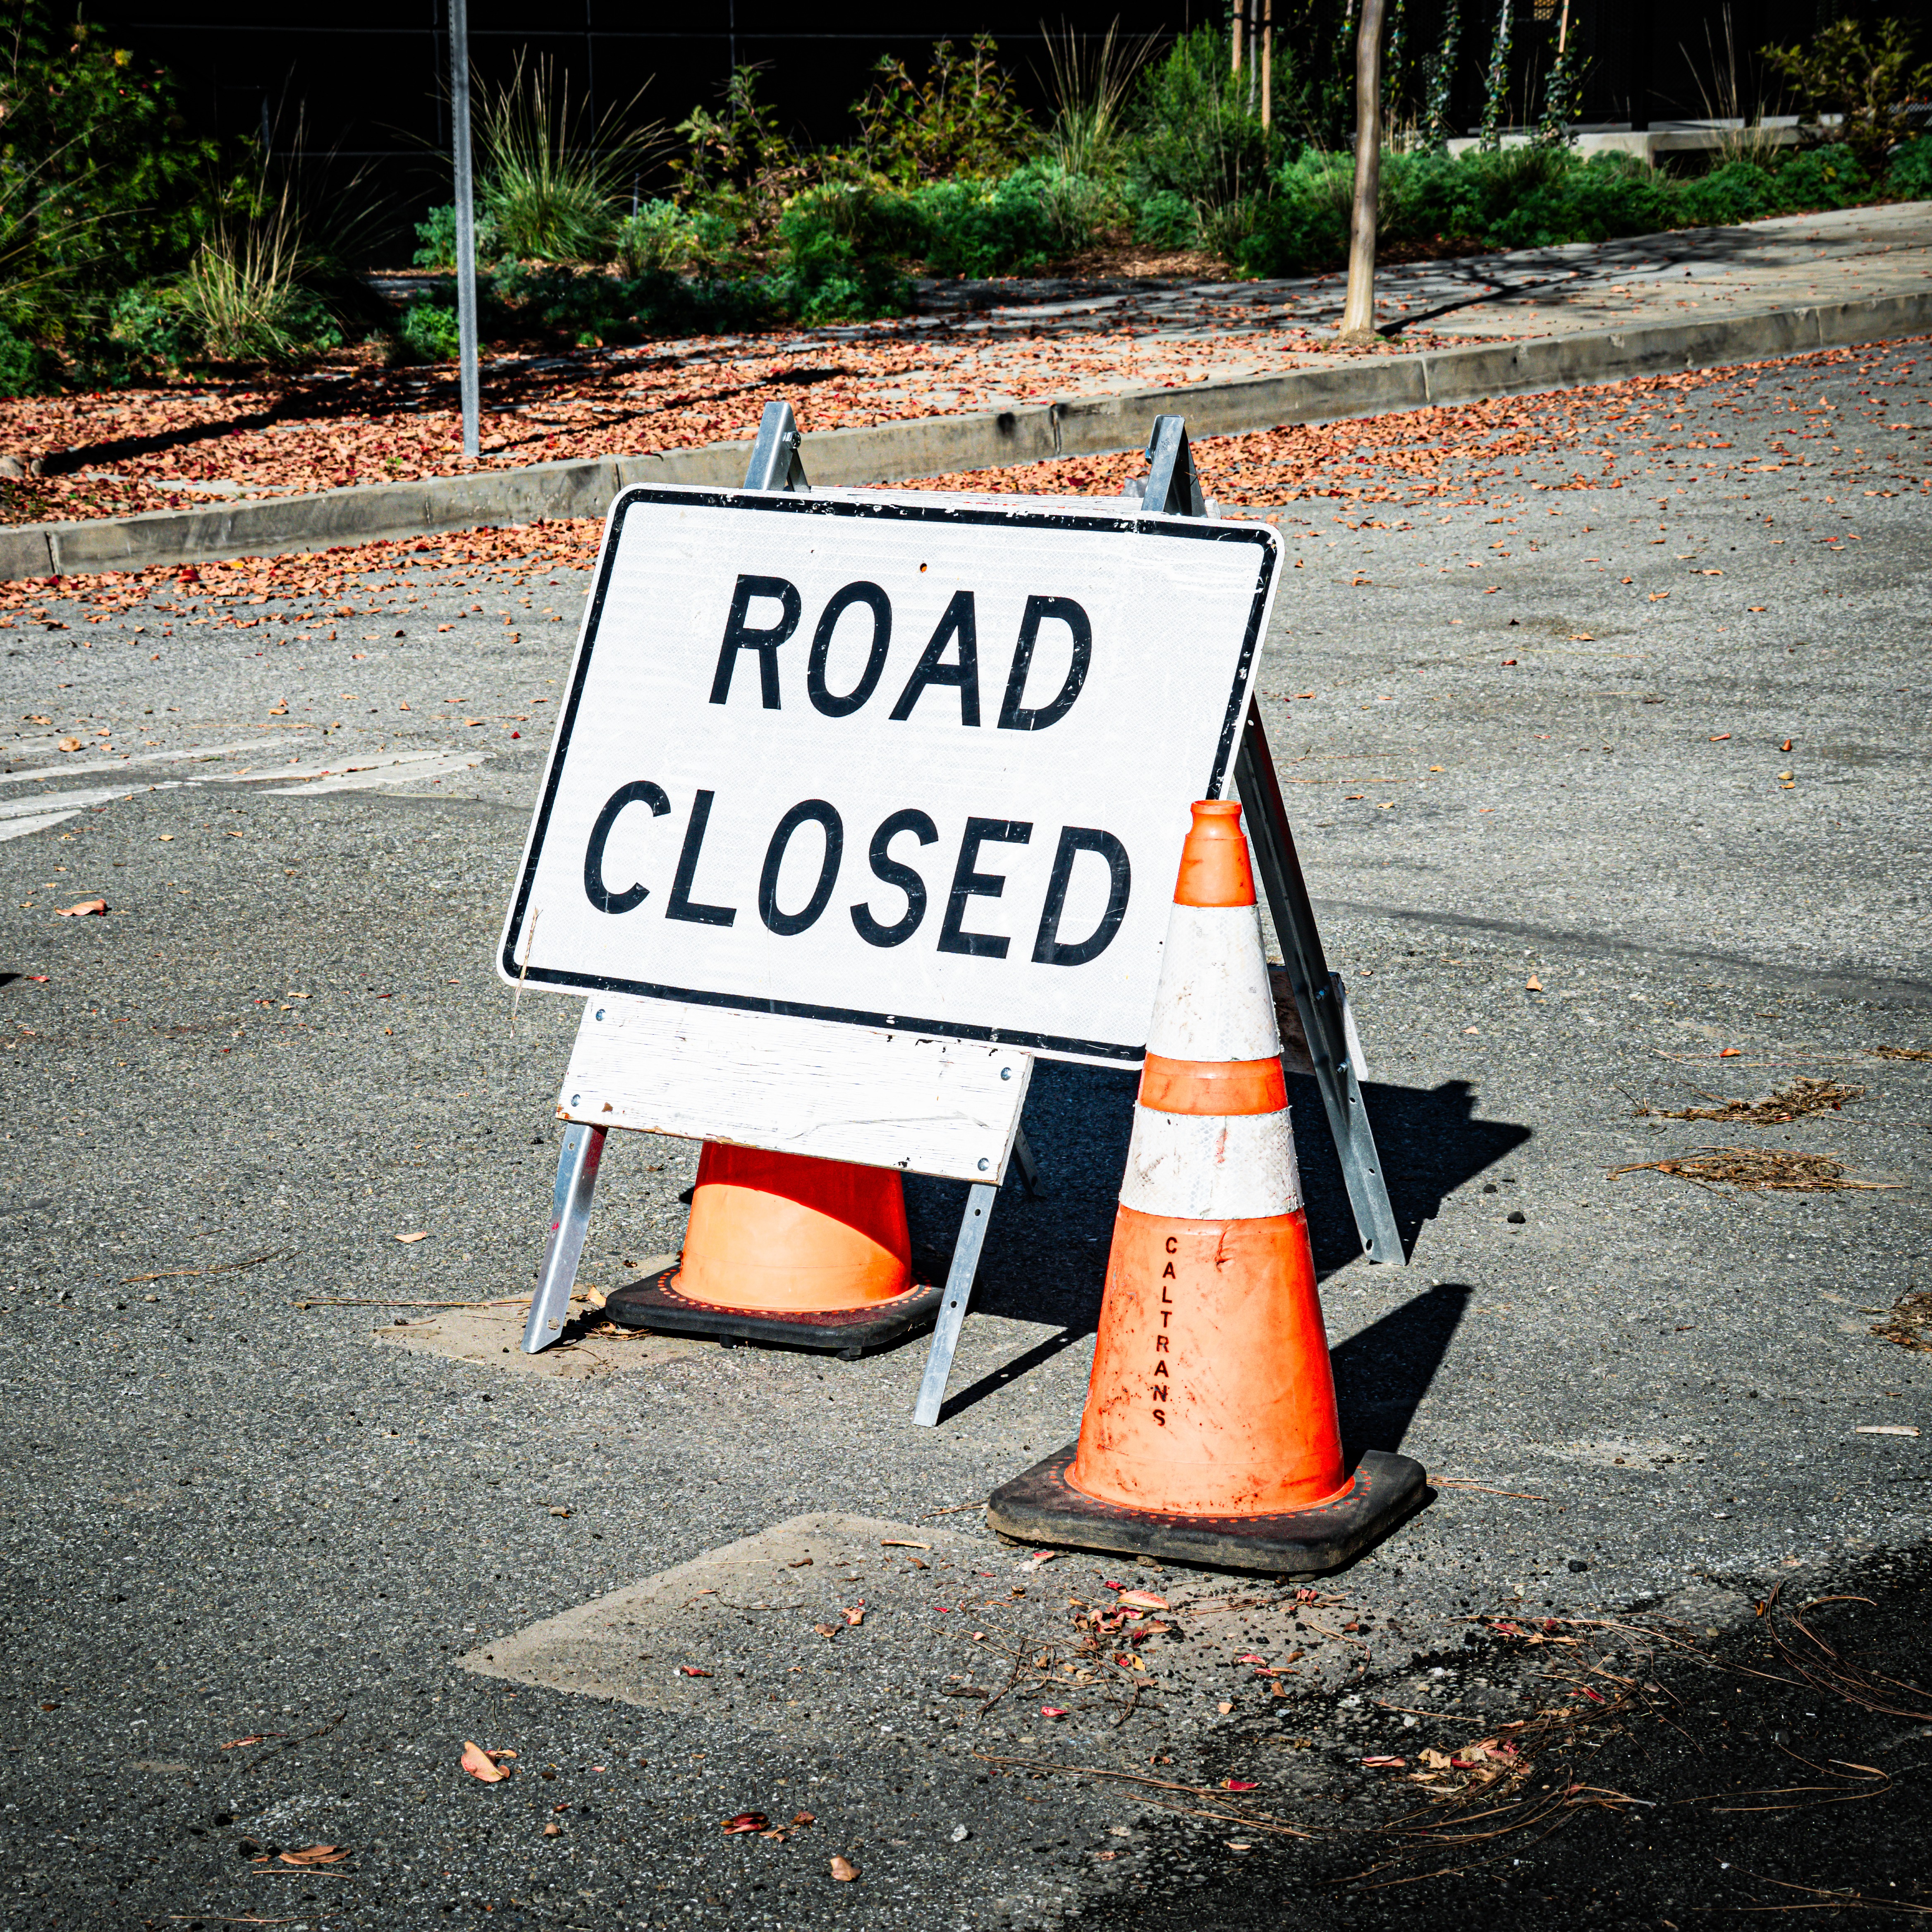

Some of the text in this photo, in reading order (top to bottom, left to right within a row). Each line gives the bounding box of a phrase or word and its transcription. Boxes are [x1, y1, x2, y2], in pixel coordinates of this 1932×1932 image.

[709, 574, 1093, 731] ROAD
[583, 779, 1132, 967] CLOSED
[1152, 1236, 1177, 1427] CALTRANS
